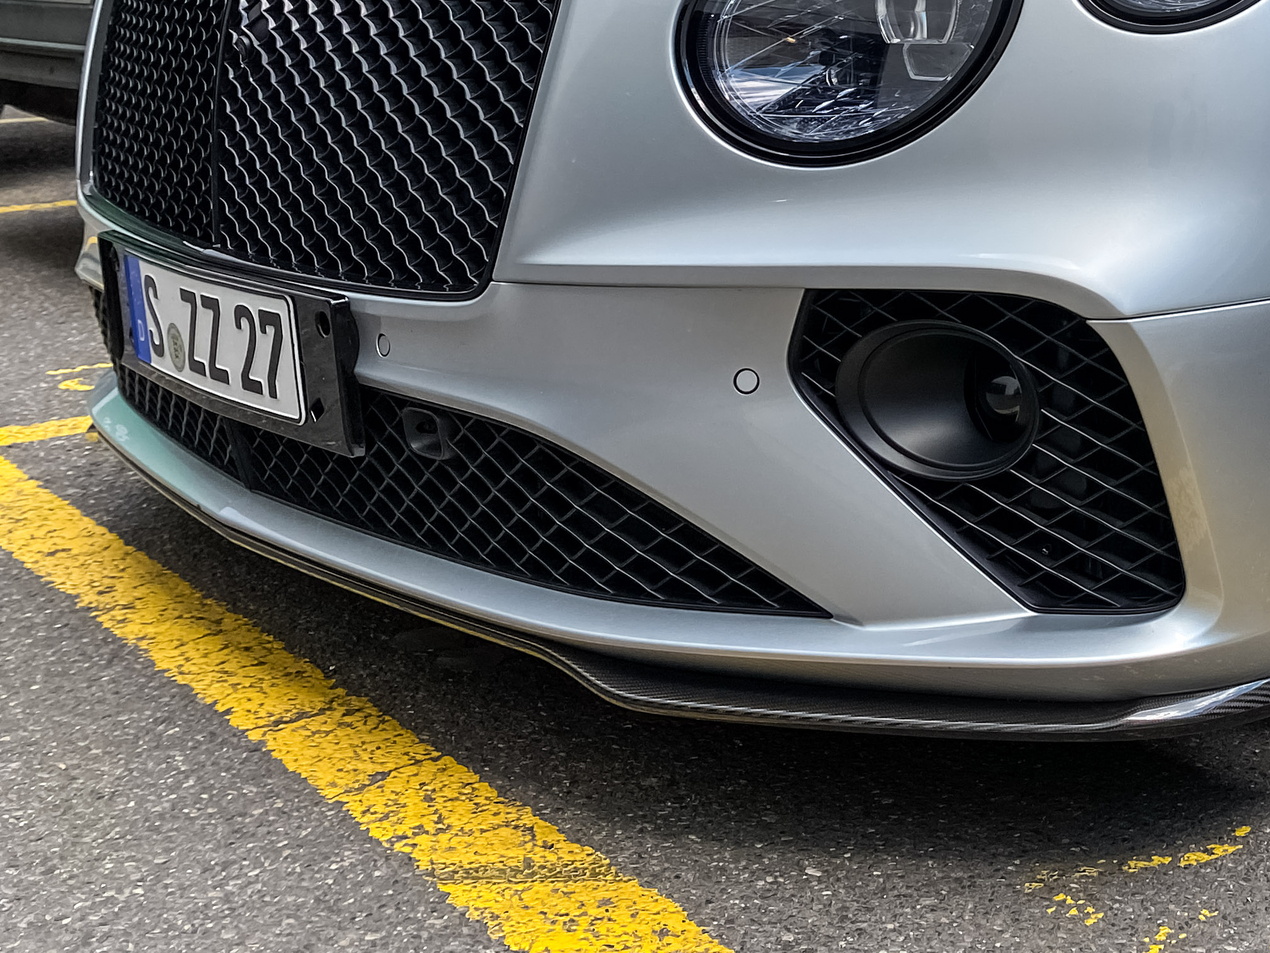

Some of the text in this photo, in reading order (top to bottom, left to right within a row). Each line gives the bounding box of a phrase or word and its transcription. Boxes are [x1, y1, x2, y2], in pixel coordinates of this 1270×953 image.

[143, 274, 166, 358] S
[179, 287, 231, 386] ZZ
[233, 304, 284, 400] 27
